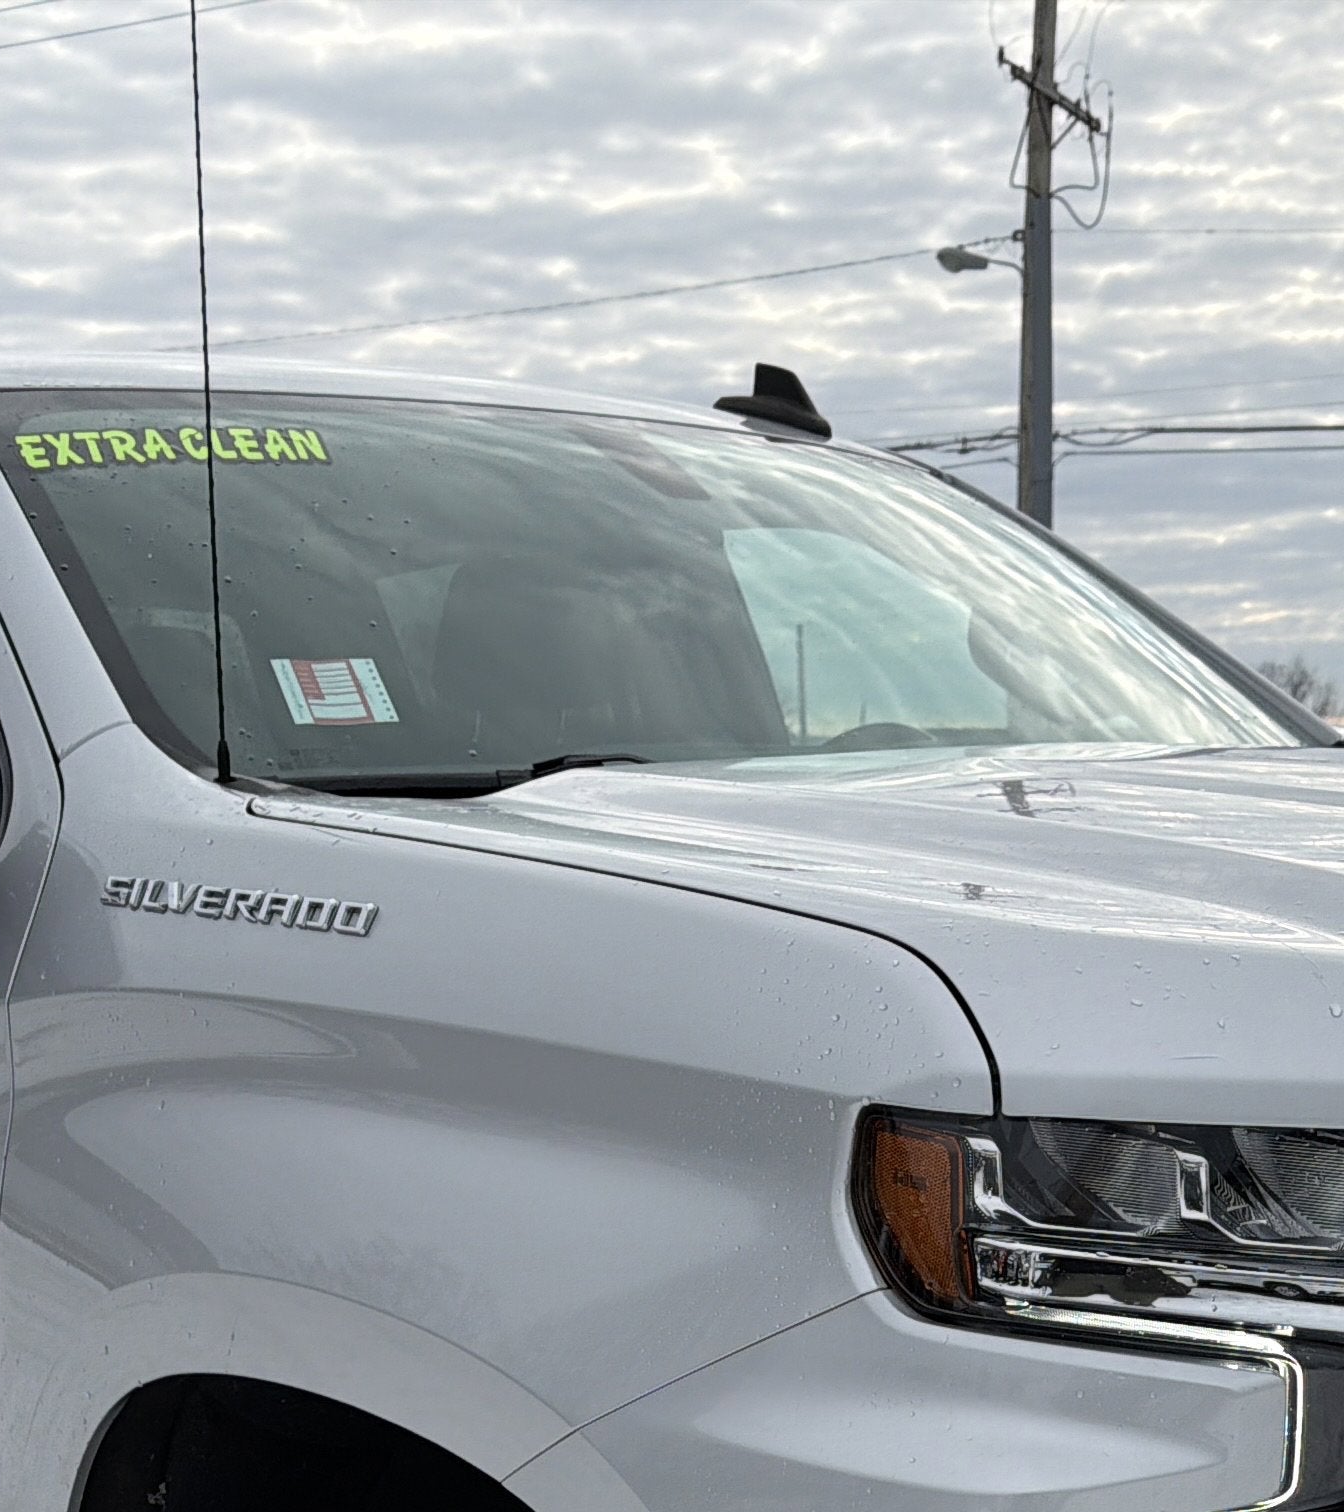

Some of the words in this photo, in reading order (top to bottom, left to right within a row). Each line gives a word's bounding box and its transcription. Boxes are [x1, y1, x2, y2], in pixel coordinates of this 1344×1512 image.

[15, 428, 174, 469] EXTRA
[178, 428, 329, 462] CLEAN
[101, 875, 379, 937] SILVERADO
